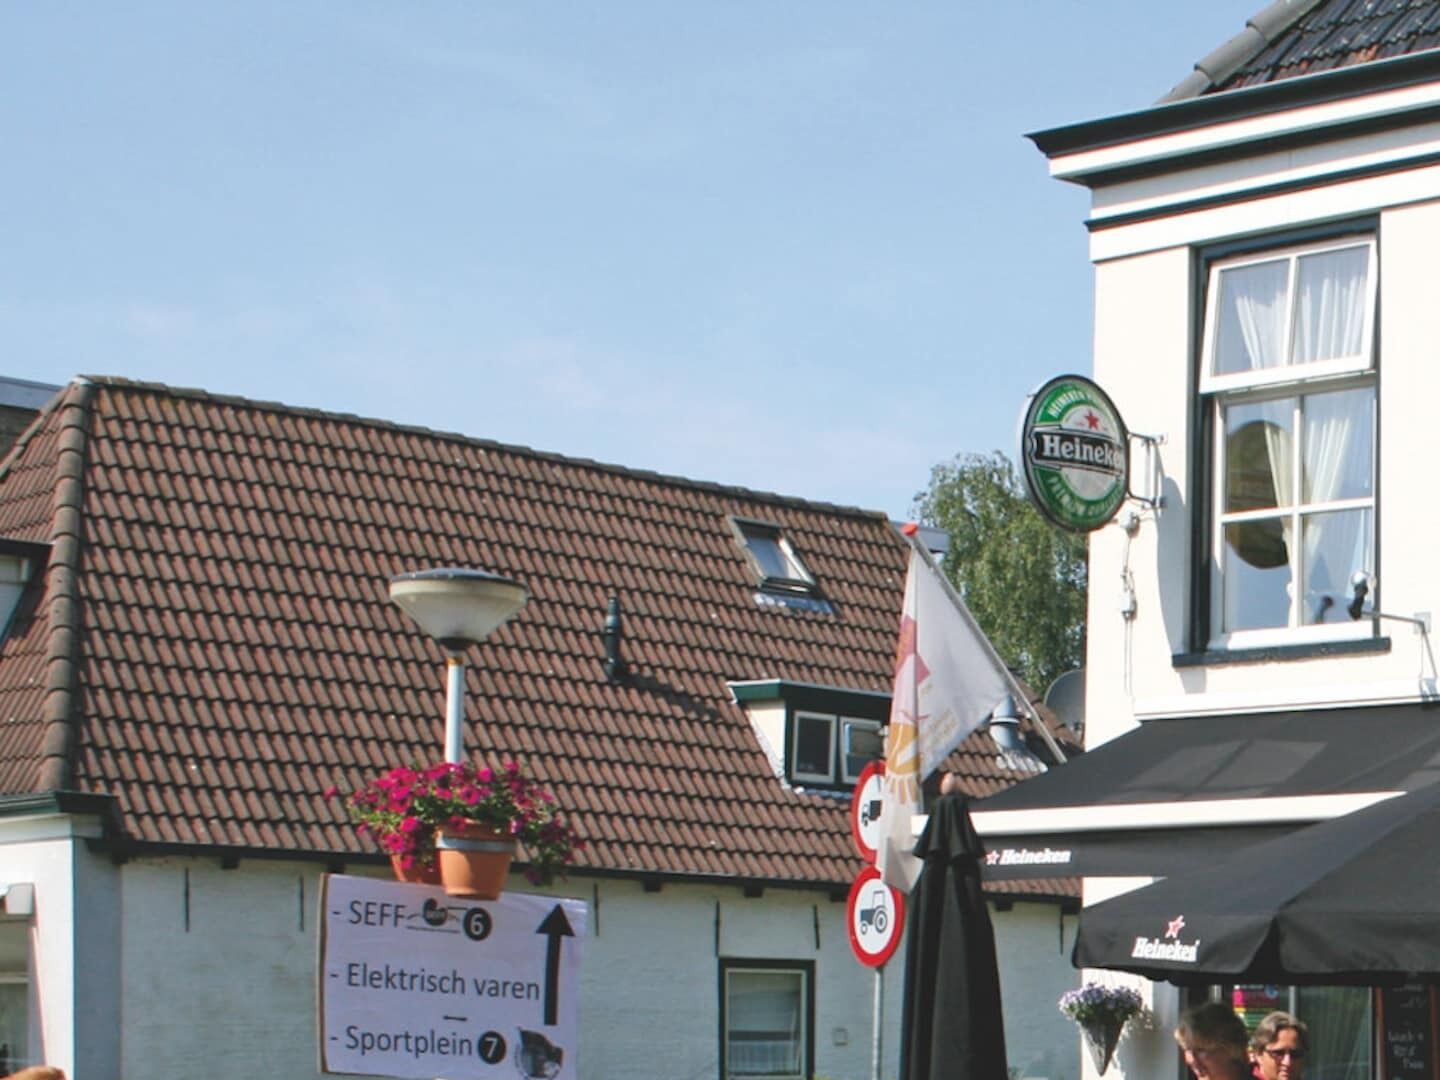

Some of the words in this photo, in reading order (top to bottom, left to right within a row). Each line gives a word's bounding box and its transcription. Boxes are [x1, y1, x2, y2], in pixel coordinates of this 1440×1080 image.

[1042, 434, 1121, 465] Heineke
[999, 847, 1072, 865] Heineken
[348, 899, 406, 928] SEFF
[1131, 936, 1199, 962] Heineken
[346, 962, 466, 996] Elektrisch
[474, 979, 541, 1001] varen
[345, 1025, 473, 1059] Sportplein
